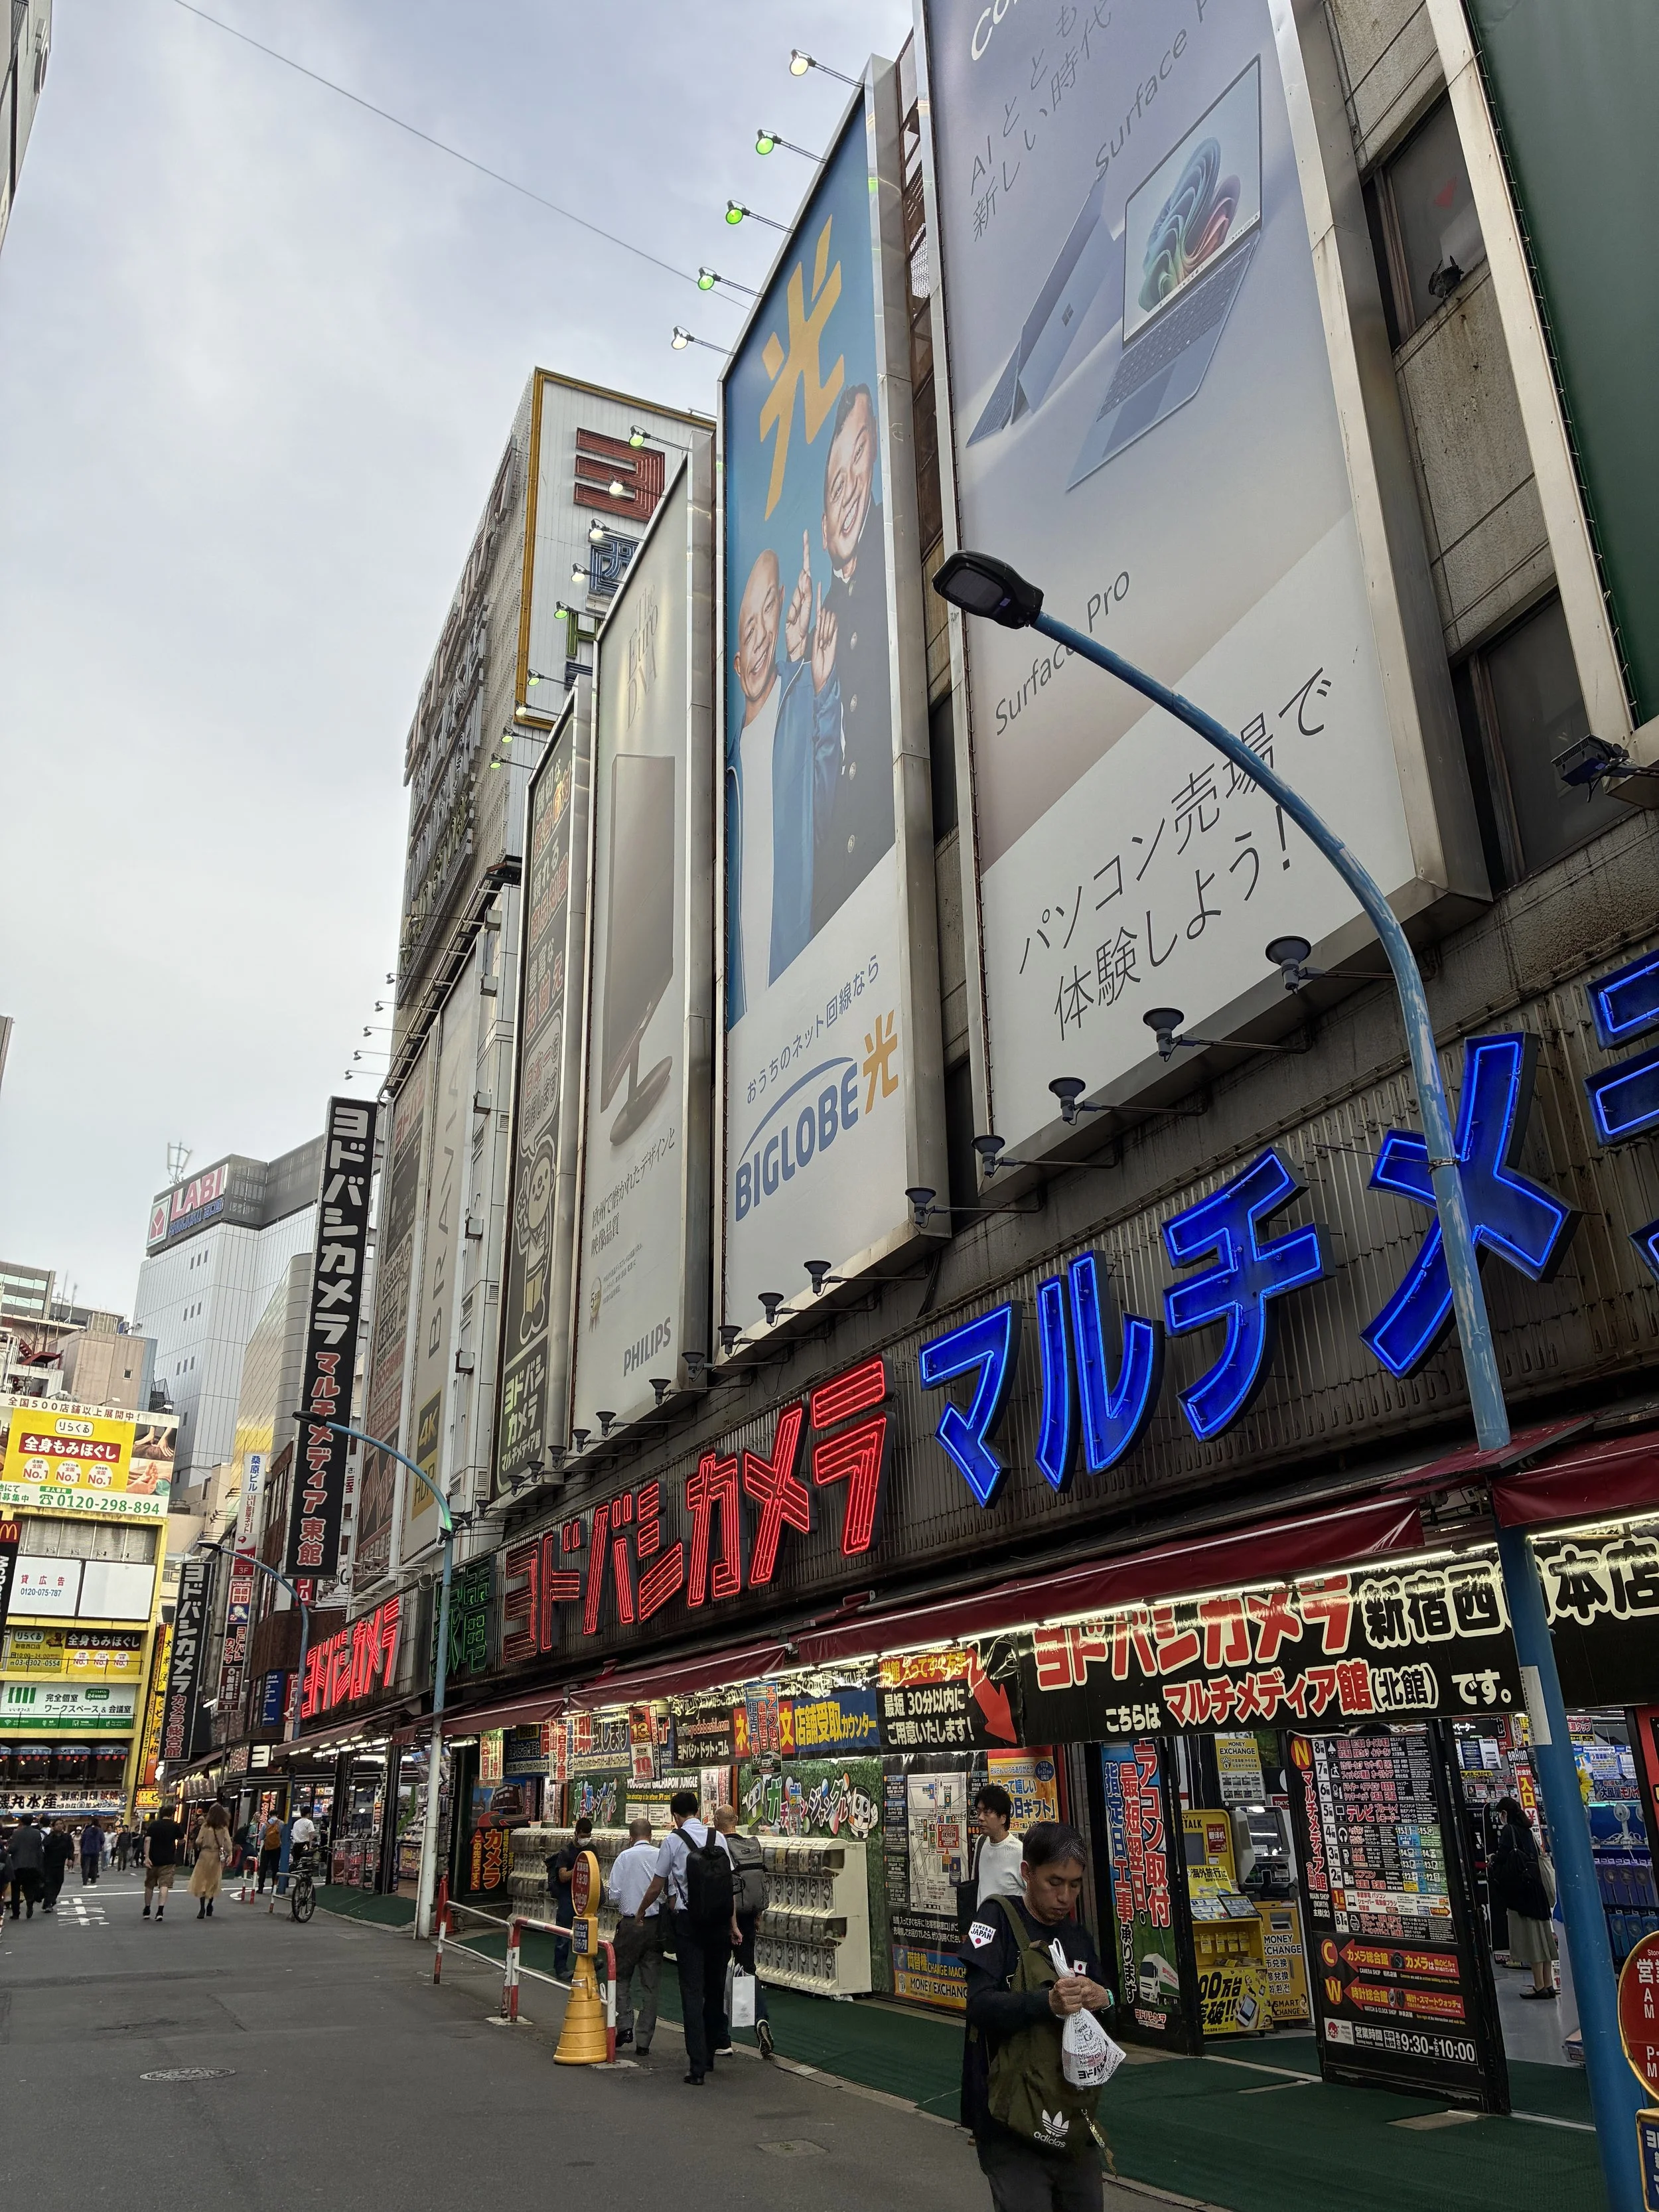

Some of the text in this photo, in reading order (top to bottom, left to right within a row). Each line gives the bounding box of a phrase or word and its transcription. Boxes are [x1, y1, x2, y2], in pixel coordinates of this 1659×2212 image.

[1095, 29, 1187, 181] Surface
[760, 214, 845, 522] 光
[995, 571, 1130, 735] Surfac Pro
[1019, 667, 1332, 974] パソコン売場で
[747, 954, 879, 1106] おうちのネット回線なら
[735, 1009, 899, 1222] BIGLOBE 光
[170, 1167, 223, 1222] LABI
[314, 1106, 369, 1345] ヨドバシカメラ
[623, 1316, 671, 1377] PHILIPS
[504, 1352, 545, 1416] ヨドバシ
[8, 1396, 141, 1422] 全国500店舗以上展開中!
[59, 1422, 90, 1434] りらくる
[508, 1399, 539, 1447] カメラ
[25, 1436, 117, 1460] 全身もみほぐし
[23, 1469, 48, 1480] No.1
[56, 1472, 80, 1483] No.1
[88, 1475, 112, 1486] No.1
[248, 1455, 261, 1492] 桑原ビル
[57, 1494, 160, 1515] 0120-298-894
[504, 1355, 889, 1664] ヨドバシカメラ
[21, 1587, 62, 1597] 0120-075-787
[68, 1633, 140, 1648] 全身もみほぐし
[172, 1564, 205, 1693] ヨドバシカメラ
[1032, 1574, 1354, 1691] ヨドバシカメラ
[224, 1637, 235, 1664] カメラ
[234, 1626, 246, 1661] ヨドバシ
[44, 1704, 98, 1714] ワークスペース
[45, 1694, 79, 1702] 完全個室
[885, 1688, 965, 1718] 最短 30分以内に
[1106, 1702, 1162, 1732] こちらは
[1452, 1667, 1512, 1706] です。
[677, 1718, 729, 1738] www.yodobashi.com
[794, 1700, 876, 1747] 店舗受取カウンター
[887, 1717, 975, 1745] ご用意いたします!
[677, 1739, 729, 1760] ヨドバシ・ドット・コム
[1294, 1739, 1311, 1767] N
[1507, 1747, 1528, 1763] BRAUN
[680, 1775, 698, 1789] JUNGLE
[1520, 1777, 1534, 1806] 入口
[1346, 1804, 1374, 1822] テレビ
[1301, 1771, 1328, 1892] マルチメディア館
[483, 1828, 502, 1889] カメラ
[1192, 1867, 1228, 1879] 海外旅行に
[1354, 1870, 1376, 1880] エアコン
[970, 1927, 993, 1941] JAPAN
[972, 1923, 993, 1934] SAMURAI
[1263, 1933, 1293, 1943] MONEY
[906, 1951, 928, 1972] 両替機
[1323, 1942, 1334, 1964] C
[1346, 1949, 1389, 1966] カメラ総合館
[1636, 1958, 1659, 1984] 営
[910, 1977, 932, 1992] MONEY
[1325, 1978, 1341, 2002] W
[1274, 1999, 1299, 2008] SMART
[1354, 2026, 1383, 2041] 営業時間
[1439, 2039, 1475, 2061] 10:00
[1033, 2130, 1067, 2148] adidas
